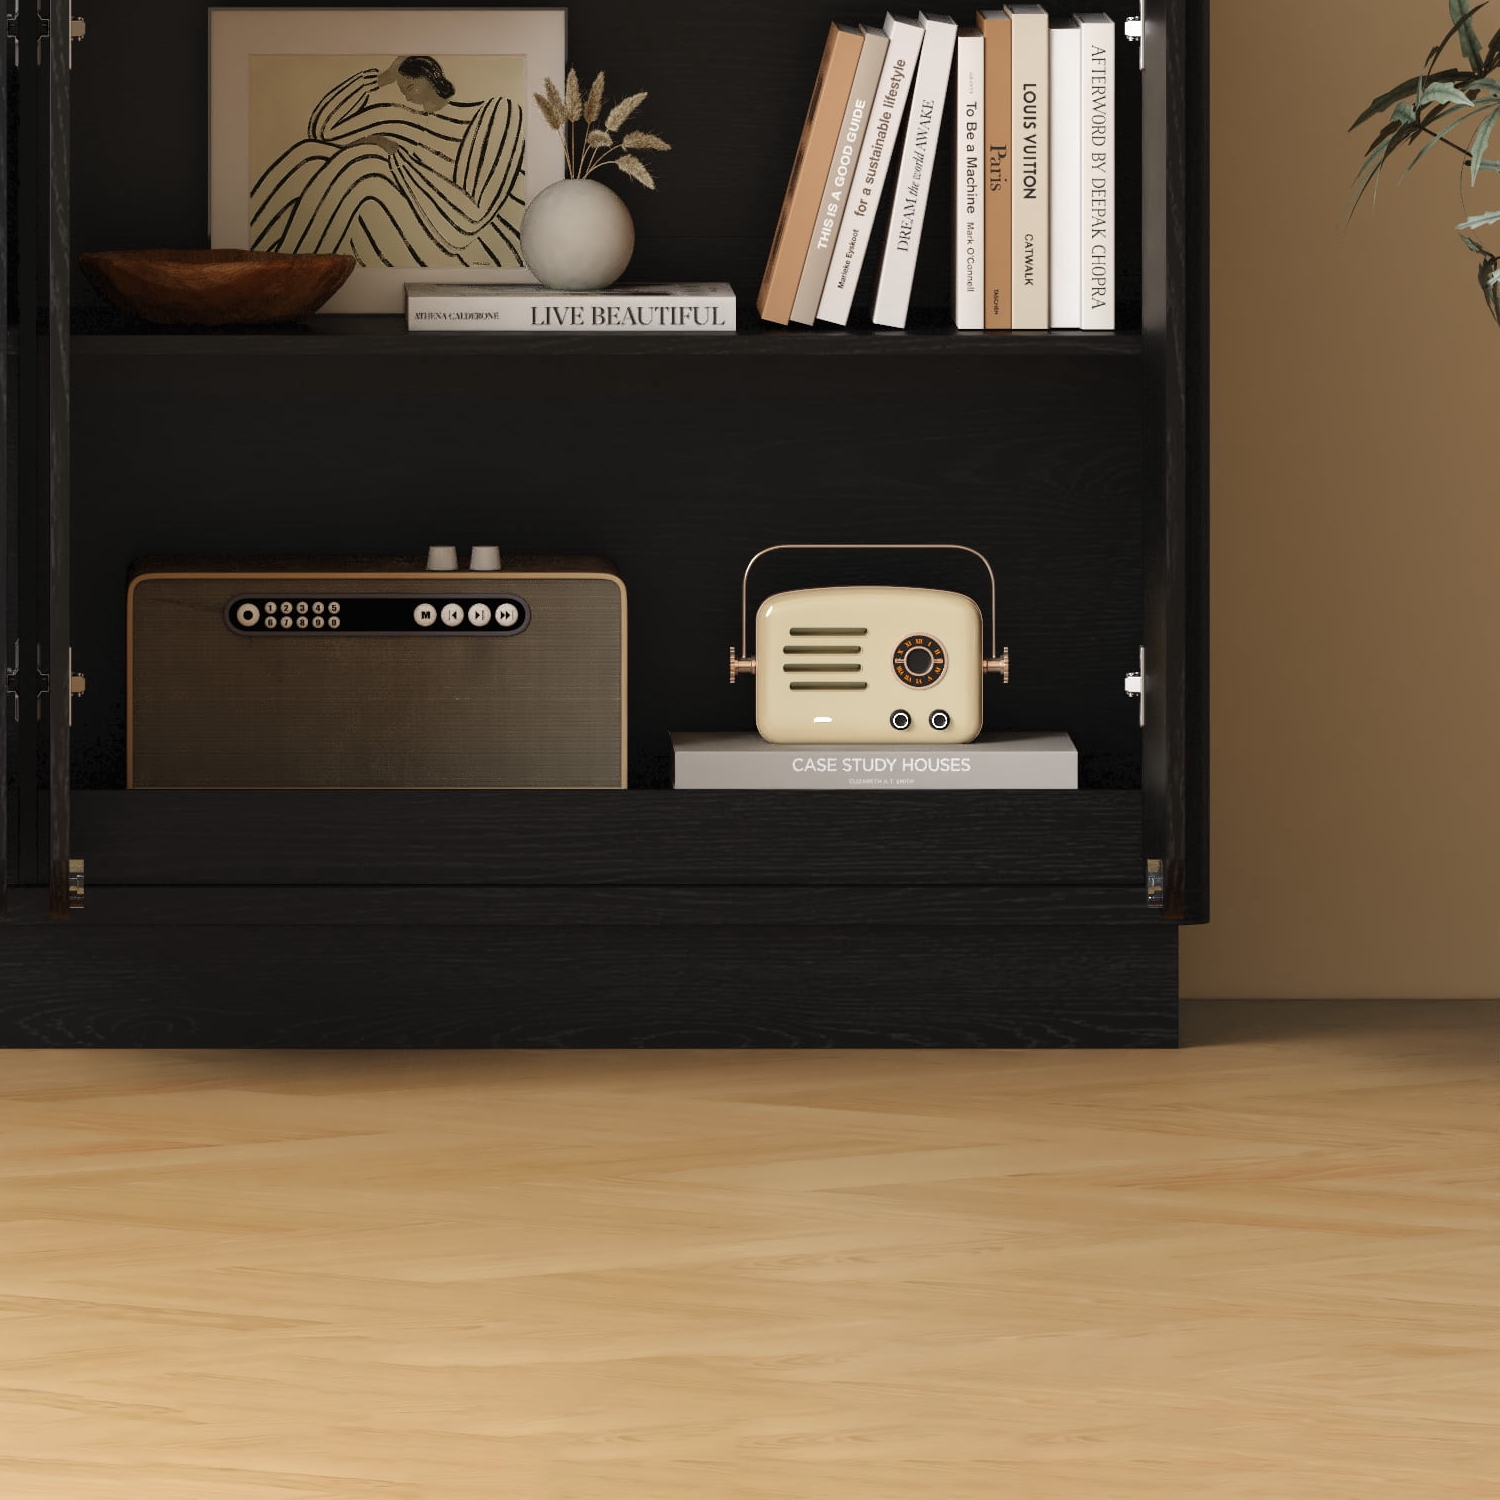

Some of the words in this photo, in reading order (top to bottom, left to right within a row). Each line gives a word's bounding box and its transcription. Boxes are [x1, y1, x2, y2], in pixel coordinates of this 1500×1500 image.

[883, 59, 906, 108] lifestyle
[1091, 45, 1107, 147] AFTERWORD
[847, 99, 866, 143] GUIDE
[966, 102, 978, 117] To
[1023, 83, 1037, 129] LOUIS
[916, 99, 935, 153] AWAKE
[966, 122, 978, 140] Be
[866, 112, 892, 185] sustainable
[966, 144, 975, 152] a
[1091, 152, 1107, 173] BY
[836, 150, 853, 188] GOOD
[913, 153, 925, 180] world
[989, 144, 1008, 192] Paris
[1023, 135, 1037, 199] VUITTON
[831, 191, 842, 201] A
[862, 187, 872, 196] a
[908, 179, 920, 196] the
[966, 157, 978, 214] Machine
[827, 204, 838, 217] IS
[854, 199, 868, 218] for
[897, 198, 917, 252] DREAM
[1091, 178, 1107, 239] DEEPAK
[817, 218, 834, 250] THIS
[966, 222, 976, 244] Mark
[837, 259, 851, 289] Marieke
[846, 229, 860, 259] Eyskoot
[966, 247, 976, 292] O'Connell
[1024, 233, 1034, 286] CATWALK
[1091, 244, 1107, 310] CHOPRA
[414, 311, 448, 321] ATHENA
[530, 306, 585, 326] LIVE
[591, 306, 726, 326] BEAUTIFUL
[421, 611, 431, 619] M
[792, 757, 838, 773] CASE
[842, 757, 898, 773] STUDY
[902, 757, 971, 773] HOUSES
